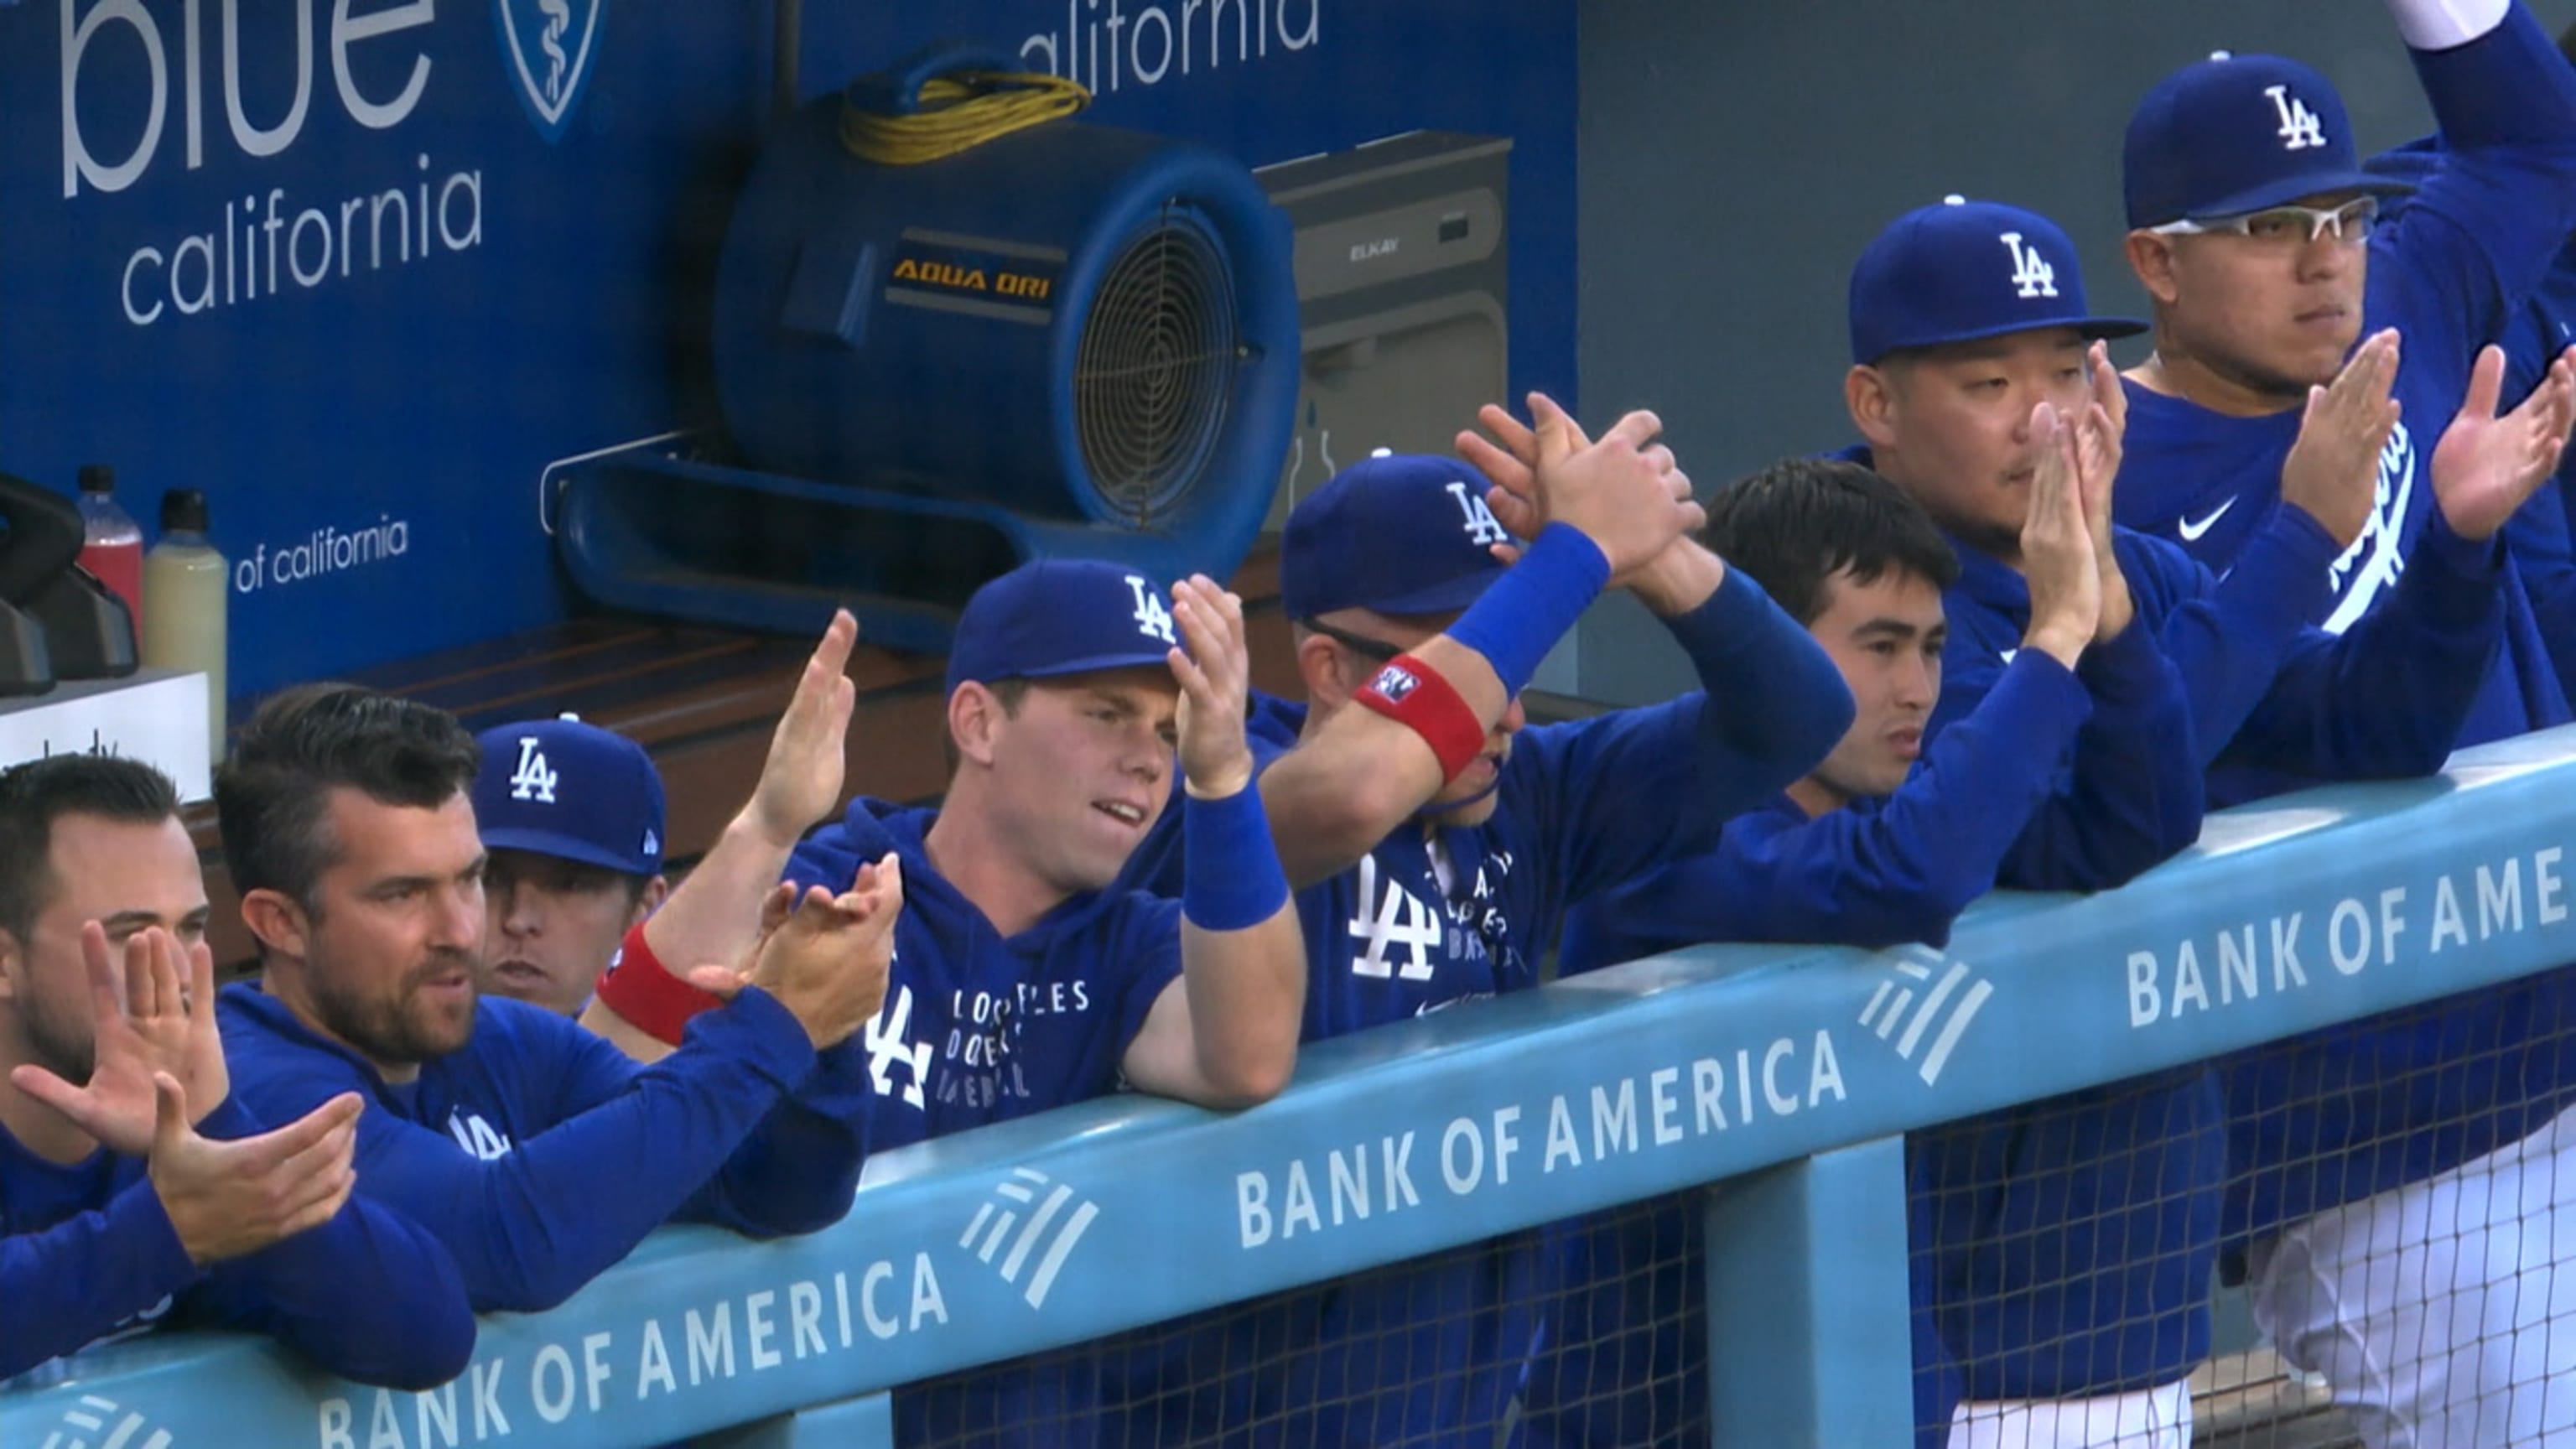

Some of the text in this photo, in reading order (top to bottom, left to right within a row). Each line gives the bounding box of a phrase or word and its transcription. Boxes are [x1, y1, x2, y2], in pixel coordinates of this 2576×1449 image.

[1020, 0, 1319, 96] alifornia
[61, 0, 434, 199] blue
[2265, 85, 2326, 150] LA
[122, 153, 481, 325] california
[2000, 232, 2058, 299] LA
[236, 514, 408, 594] of california
[1446, 481, 1508, 545] LA
[1124, 574, 1177, 645] LA
[510, 737, 558, 803] LA
[1348, 851, 1441, 981] LA
[2127, 847, 2568, 1028] BANK OF AME
[1237, 1029, 1846, 1249] BANK OF AMERICA
[319, 1252, 948, 1449] BANK OF AMERICA
